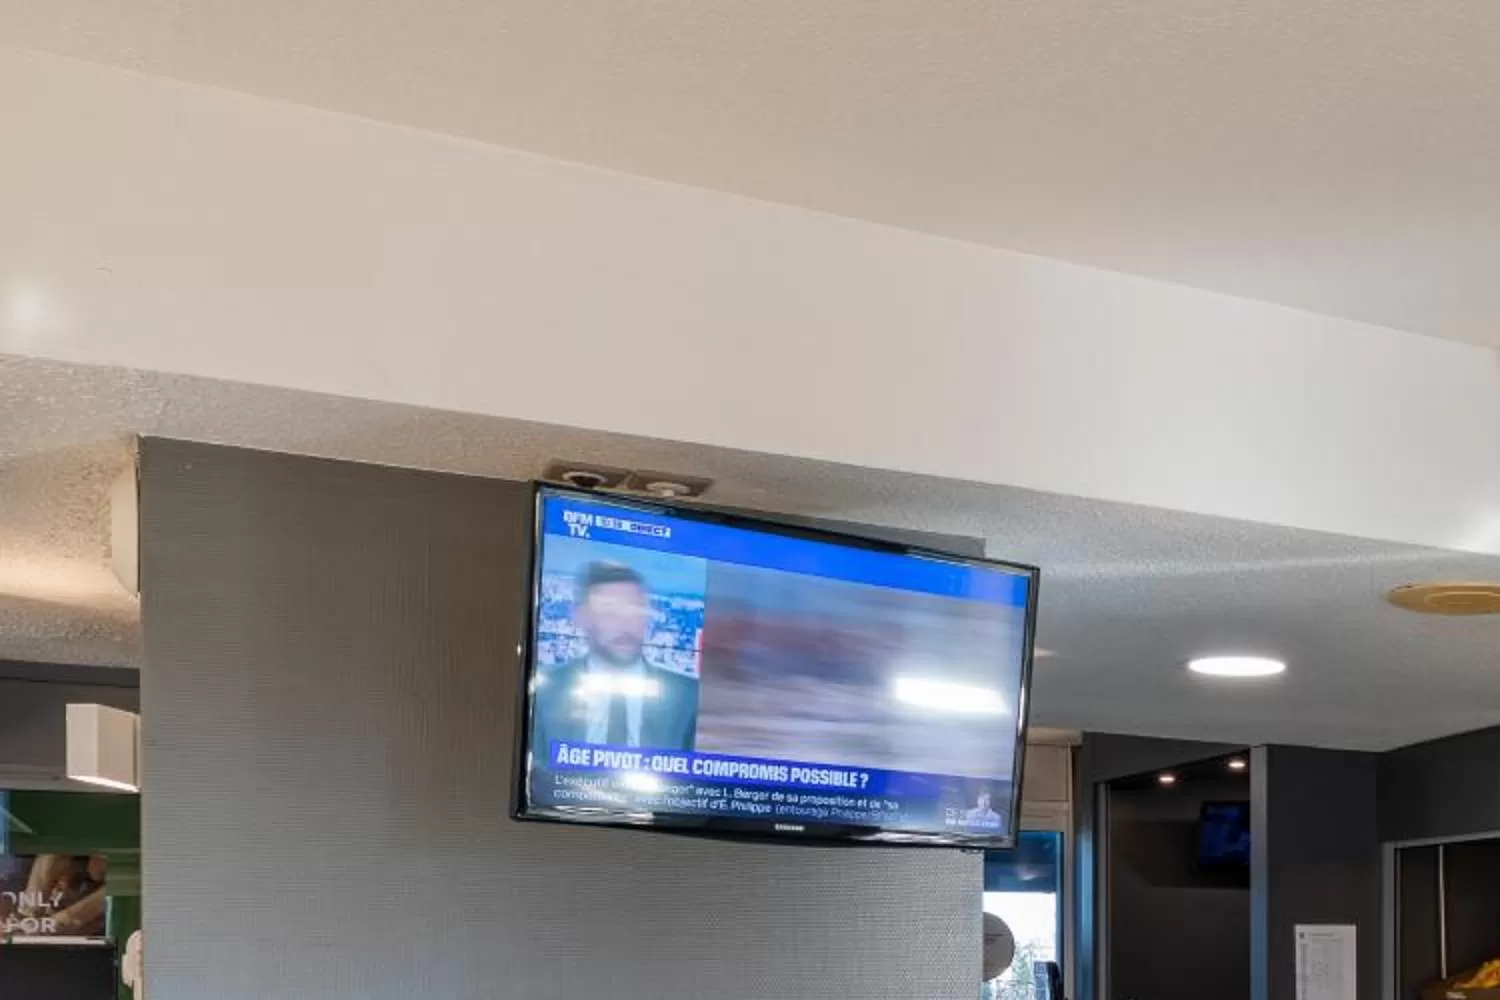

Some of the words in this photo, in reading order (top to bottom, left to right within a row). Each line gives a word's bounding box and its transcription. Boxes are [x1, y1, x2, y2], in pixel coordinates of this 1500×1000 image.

[557, 743, 591, 765] ÂGE
[593, 748, 642, 769] PIVOT
[652, 755, 689, 774] QUEL
[692, 758, 789, 783] COMPROMIS
[790, 766, 858, 788] POSSIBLE
